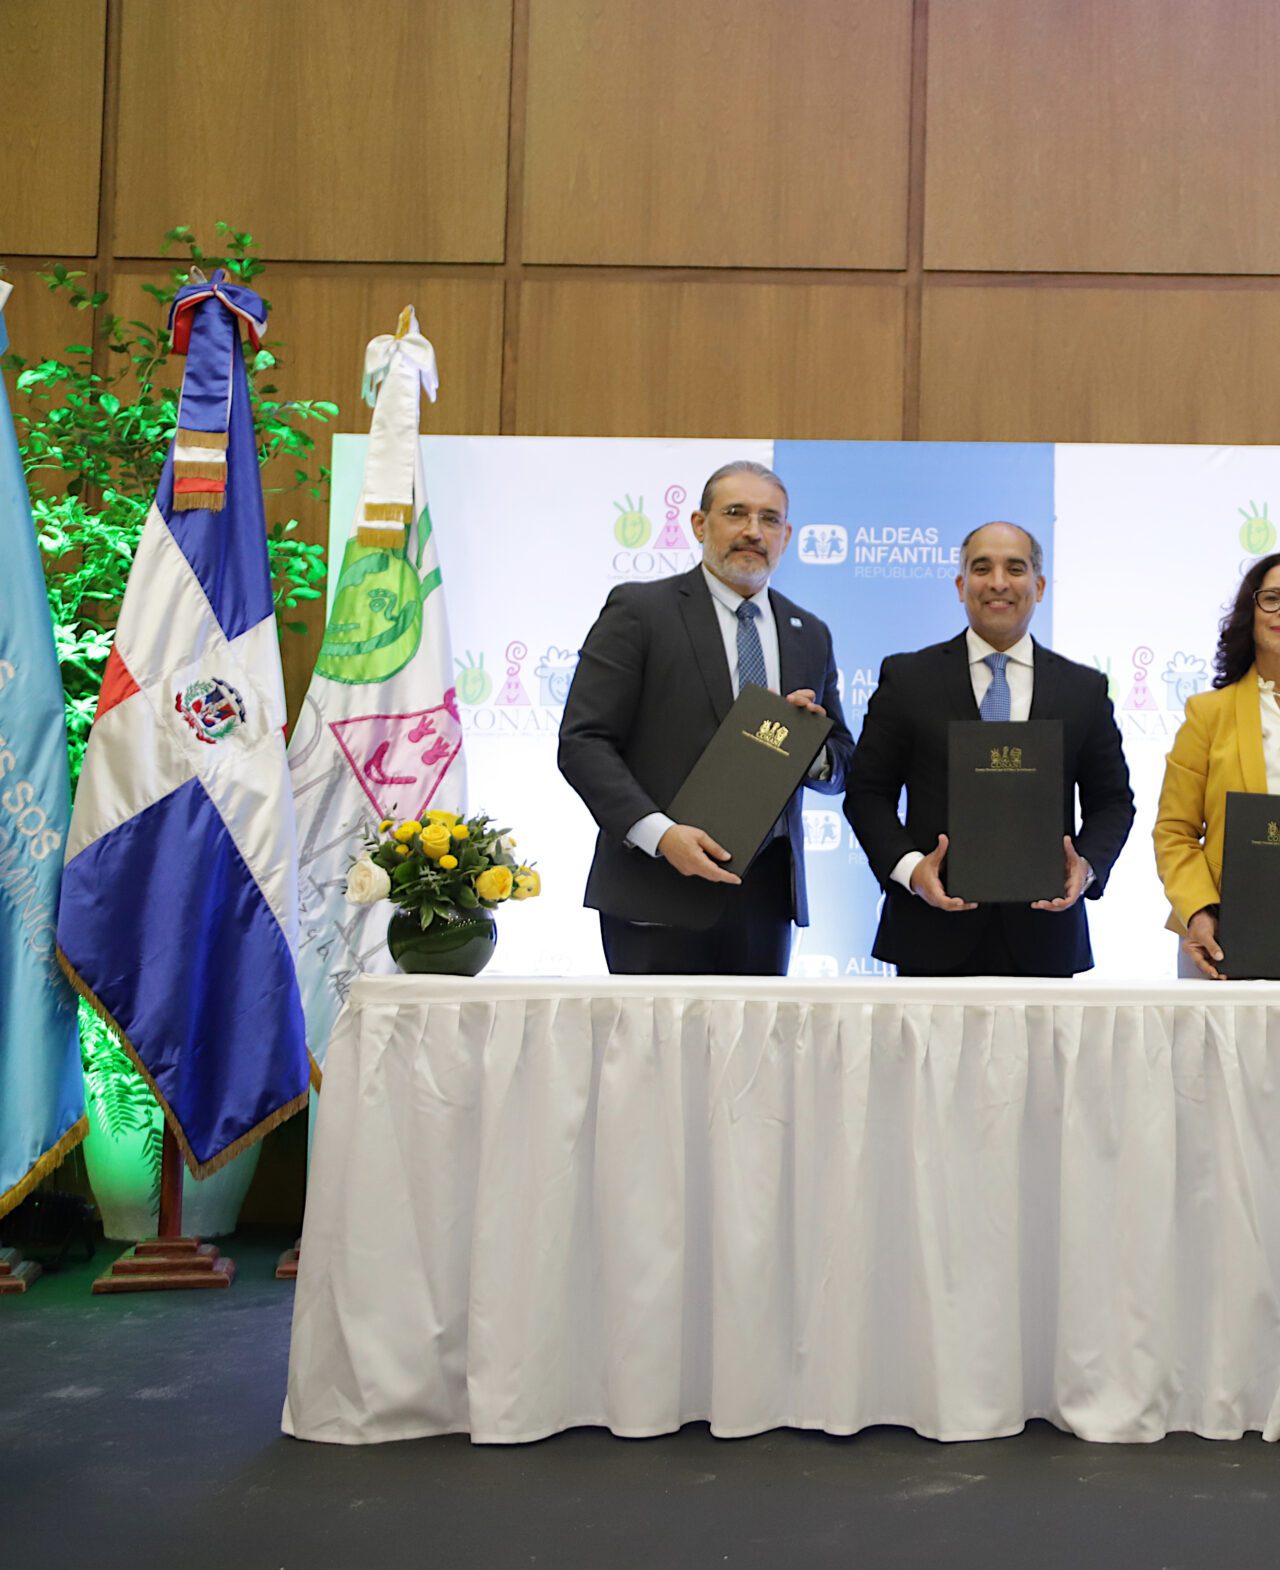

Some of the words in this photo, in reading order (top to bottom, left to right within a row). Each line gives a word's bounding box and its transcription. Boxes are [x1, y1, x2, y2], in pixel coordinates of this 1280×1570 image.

[854, 527, 939, 545] ALDEAS
[855, 547, 960, 564] INFANTILE
[2, 780, 62, 860] SOS
